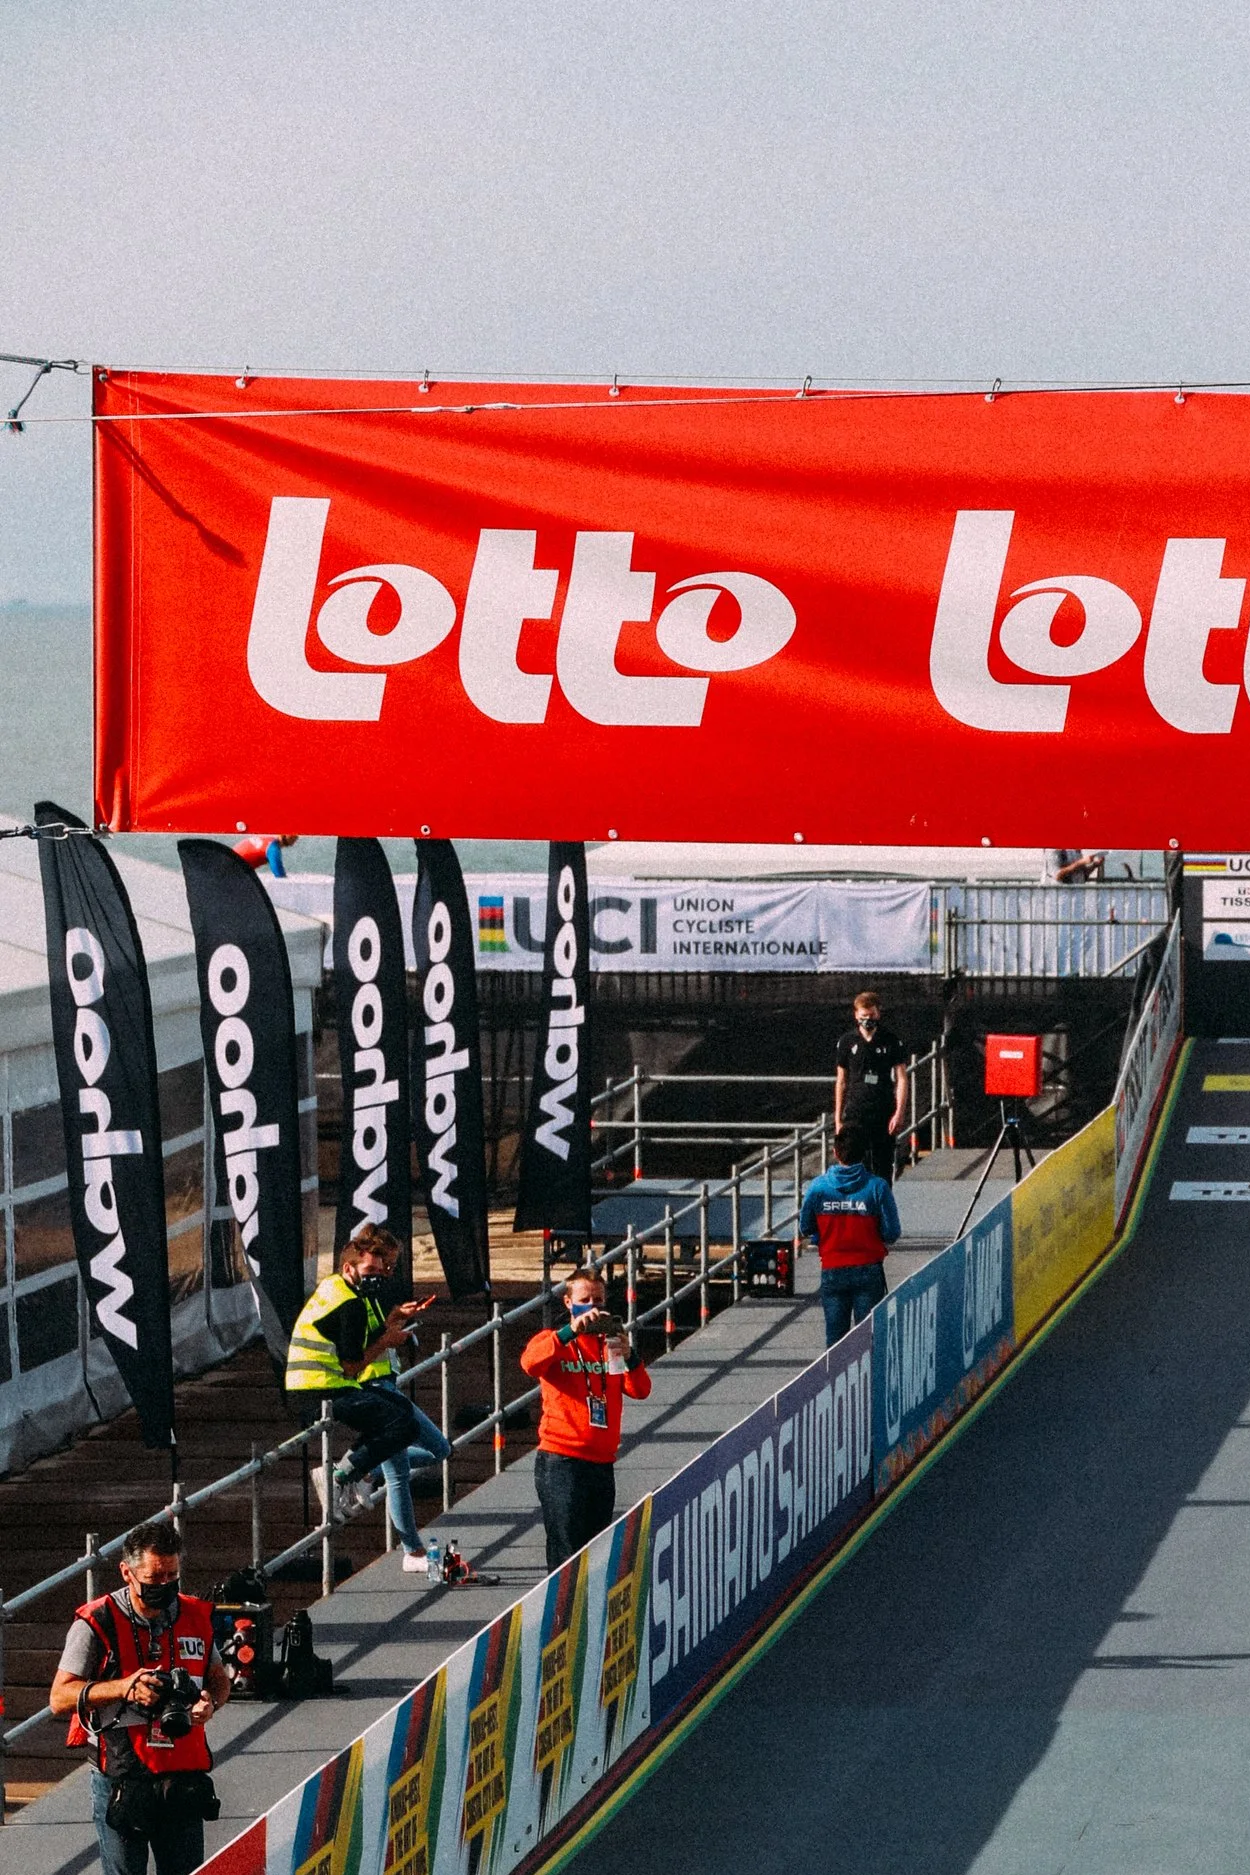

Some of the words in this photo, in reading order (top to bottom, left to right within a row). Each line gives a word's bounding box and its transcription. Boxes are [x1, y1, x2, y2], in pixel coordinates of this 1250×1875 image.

[672, 919, 755, 935] CYCLISTE
[672, 941, 829, 956] INTERNATIONALE
[673, 898, 734, 913] UNION
[423, 901, 470, 1219] wahoo
[535, 865, 585, 1161] wahoo
[66, 927, 143, 1350] wahoo
[561, 1361, 612, 1375] HUNG
[652, 1436, 774, 1687] SHIMANO
[778, 1349, 872, 1564] SHIMANO
